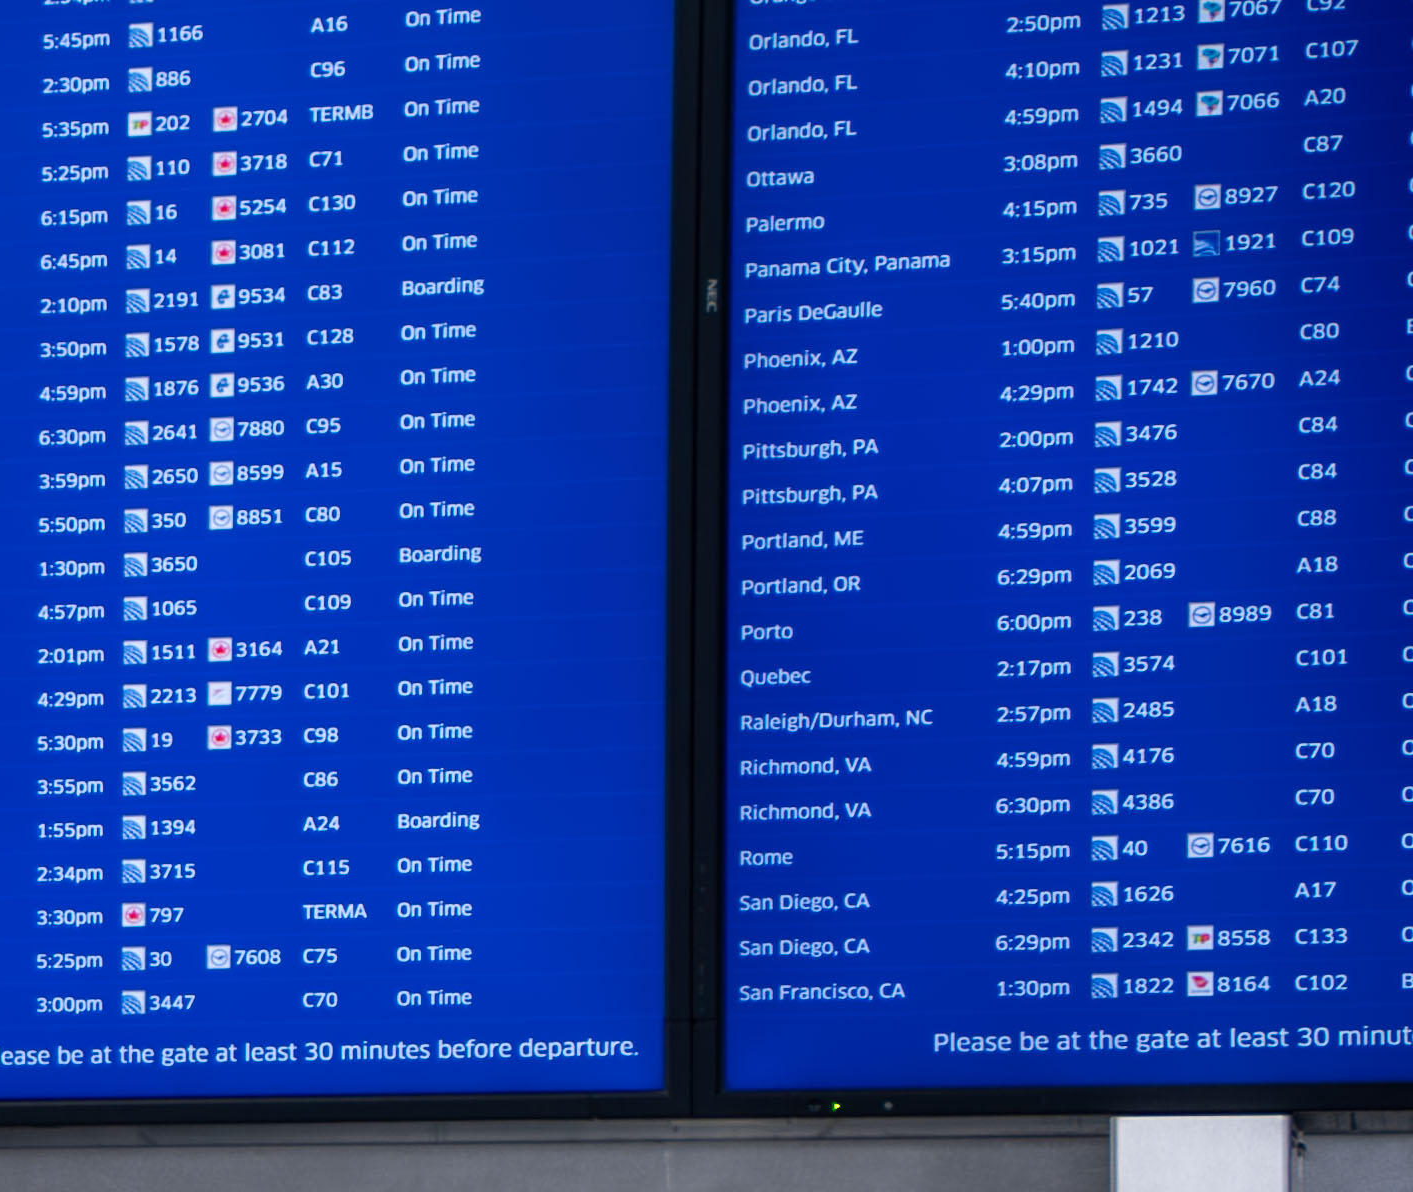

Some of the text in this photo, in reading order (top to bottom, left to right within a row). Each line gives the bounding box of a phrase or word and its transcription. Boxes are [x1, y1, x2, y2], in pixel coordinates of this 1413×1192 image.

[41, 120, 110, 139] 5:35pm
[154, 114, 191, 133] 202
[240, 108, 288, 128] 2704
[308, 103, 374, 123] TERMB
[403, 100, 430, 118] On
[434, 97, 481, 116] Time
[745, 227, 1355, 279] Panama City, Panama 3:15pm 1021 1921 C109
[39, 296, 108, 316] 2:10pm
[153, 291, 199, 309] 2191
[238, 286, 286, 305] 9534
[306, 283, 343, 302] C83
[401, 276, 485, 297] Boarding
[744, 275, 1341, 324] Paris DeGaulle 5:40pm 57 7960 C74
[38, 822, 104, 841] 1:55pm
[150, 819, 196, 836] 1394
[302, 815, 341, 832] A24
[397, 811, 481, 831] Boarding
[36, 996, 103, 1015] 3:00pm
[149, 994, 196, 1011] 3447
[302, 991, 339, 1009] C70
[396, 990, 422, 1007] On
[426, 988, 473, 1006] Time
[739, 973, 1348, 1002] San Francisco, CA 1:30pm 1822 8164 C102
[57, 1045, 84, 1065] be
[90, 1045, 113, 1065] at
[118, 1044, 155, 1064] the
[161, 1044, 209, 1067] gate
[214, 1043, 238, 1063] at
[244, 1042, 298, 1063] least
[304, 1041, 334, 1062] 30
[340, 1040, 431, 1061] minutes
[437, 1038, 513, 1060] before
[518, 1037, 639, 1061] departure.
